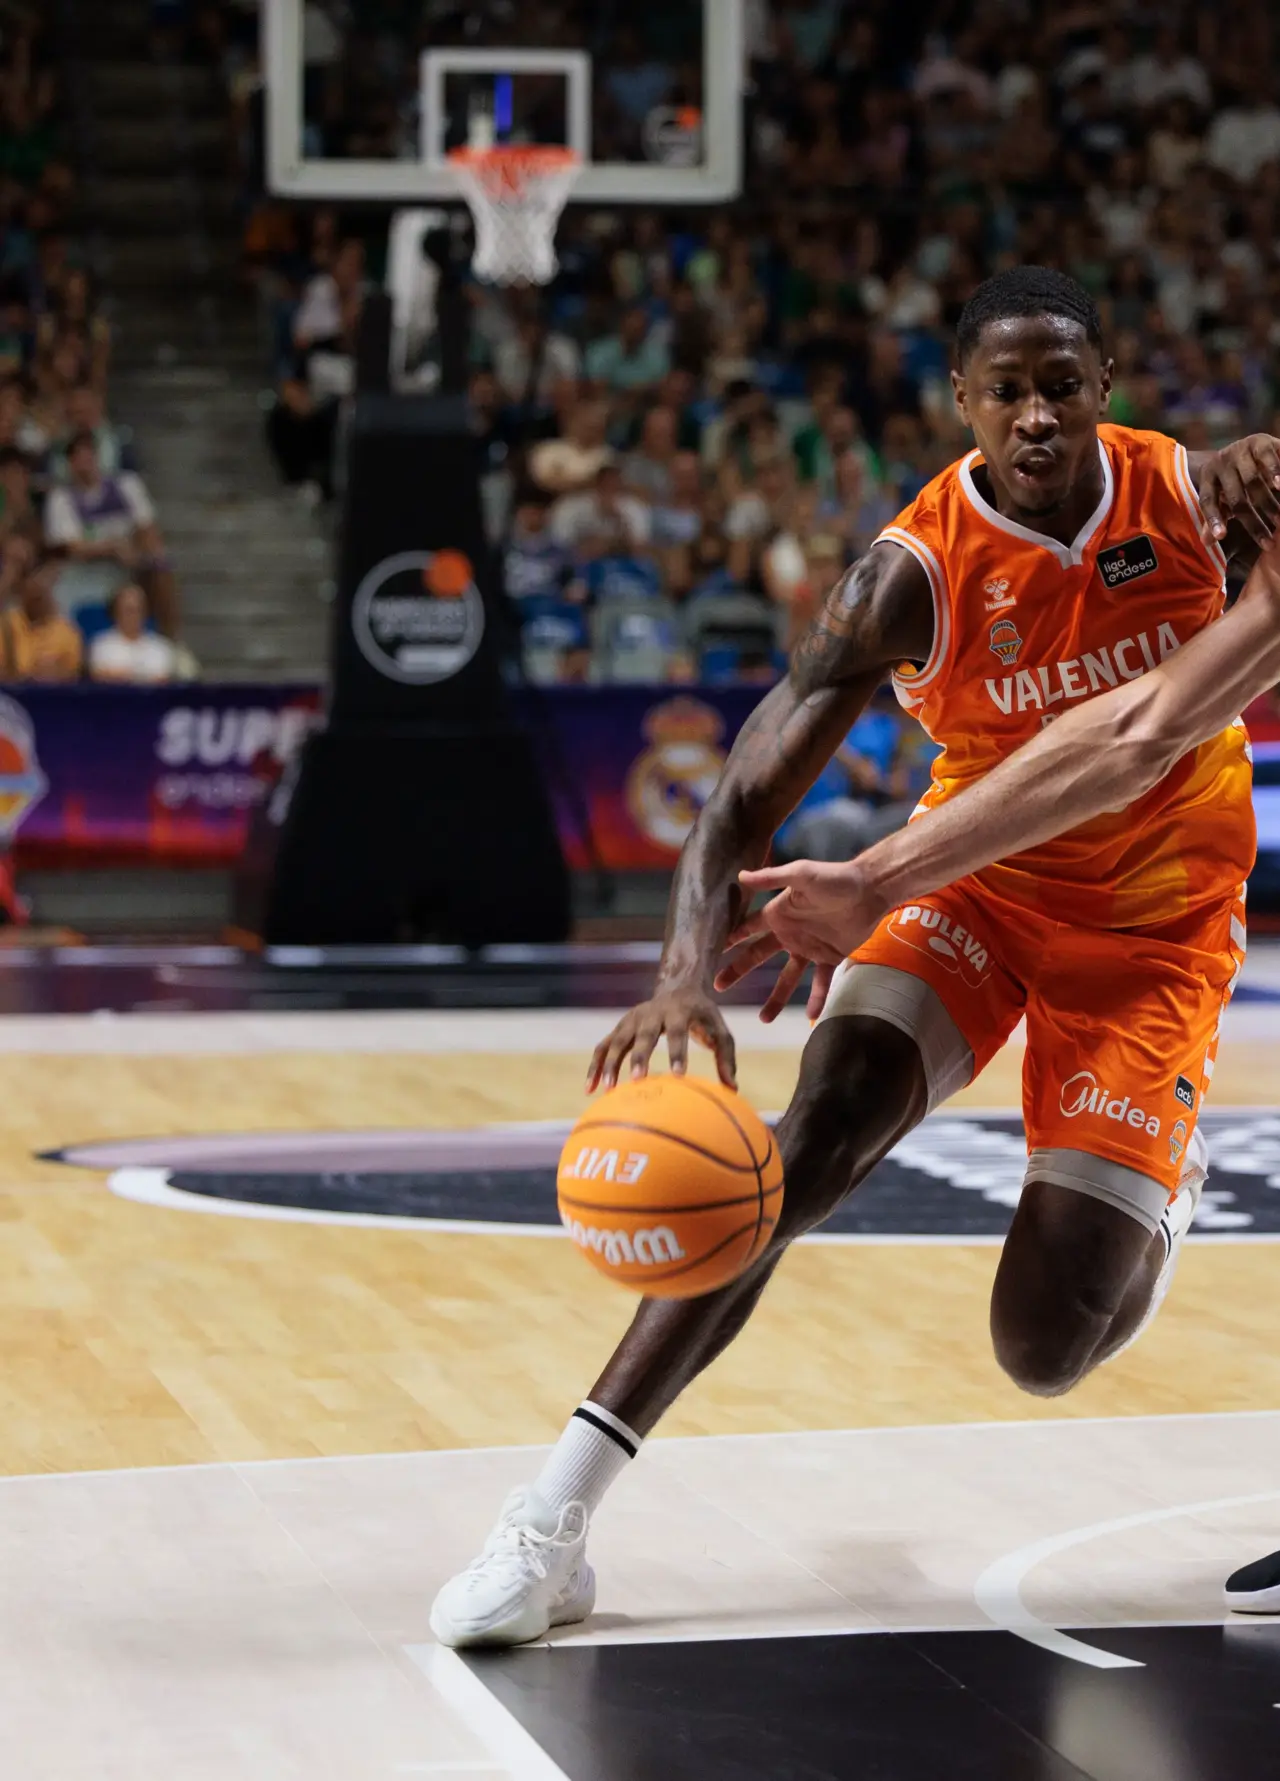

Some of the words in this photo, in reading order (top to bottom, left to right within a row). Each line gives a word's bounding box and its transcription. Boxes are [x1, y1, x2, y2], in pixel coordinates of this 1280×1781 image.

[1103, 558, 1127, 574] liga
[1108, 558, 1154, 582] endesa
[984, 621, 1182, 715] VALENCIA
[898, 905, 989, 973] PULEVA
[1062, 1080, 1161, 1138] Midea
[1176, 1085, 1192, 1105] acb
